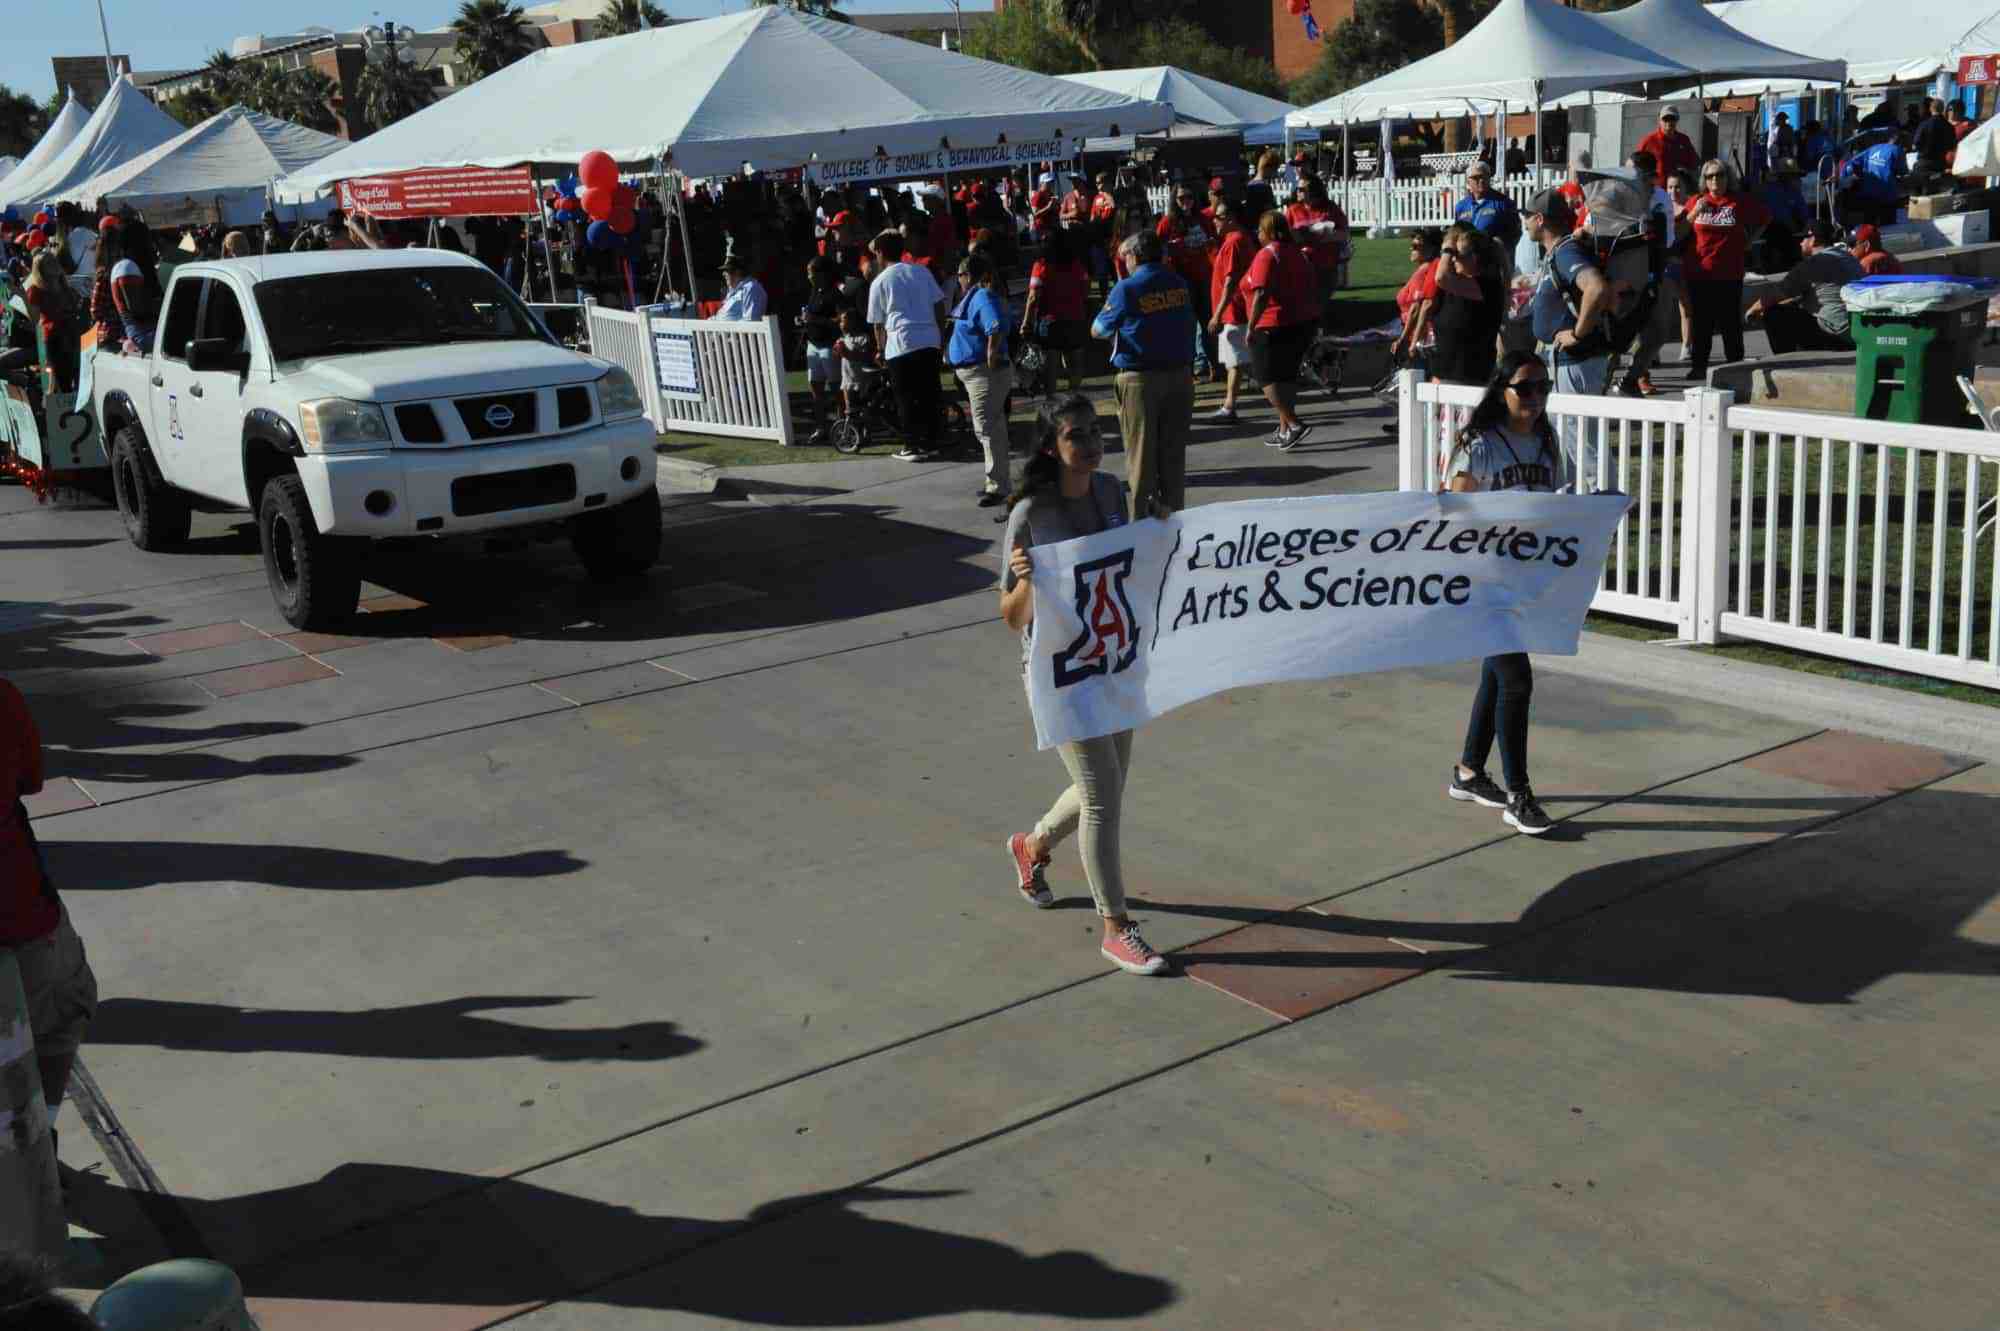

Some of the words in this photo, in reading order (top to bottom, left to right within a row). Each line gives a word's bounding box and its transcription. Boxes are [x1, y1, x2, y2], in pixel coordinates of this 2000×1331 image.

[822, 160, 871, 180] COLLEGE
[875, 159, 889, 175] OF
[895, 152, 932, 173] SOCIAL
[936, 149, 945, 169] &
[949, 145, 1013, 167] BEHAVIORAL
[1014, 140, 1062, 161] SCIENCES
[1187, 522, 1360, 572] Colleges
[1369, 519, 1430, 554] of
[1421, 519, 1580, 568] Letters
[1172, 582, 1249, 632] Arts
[1258, 569, 1294, 613] &
[1299, 566, 1472, 611] Science
